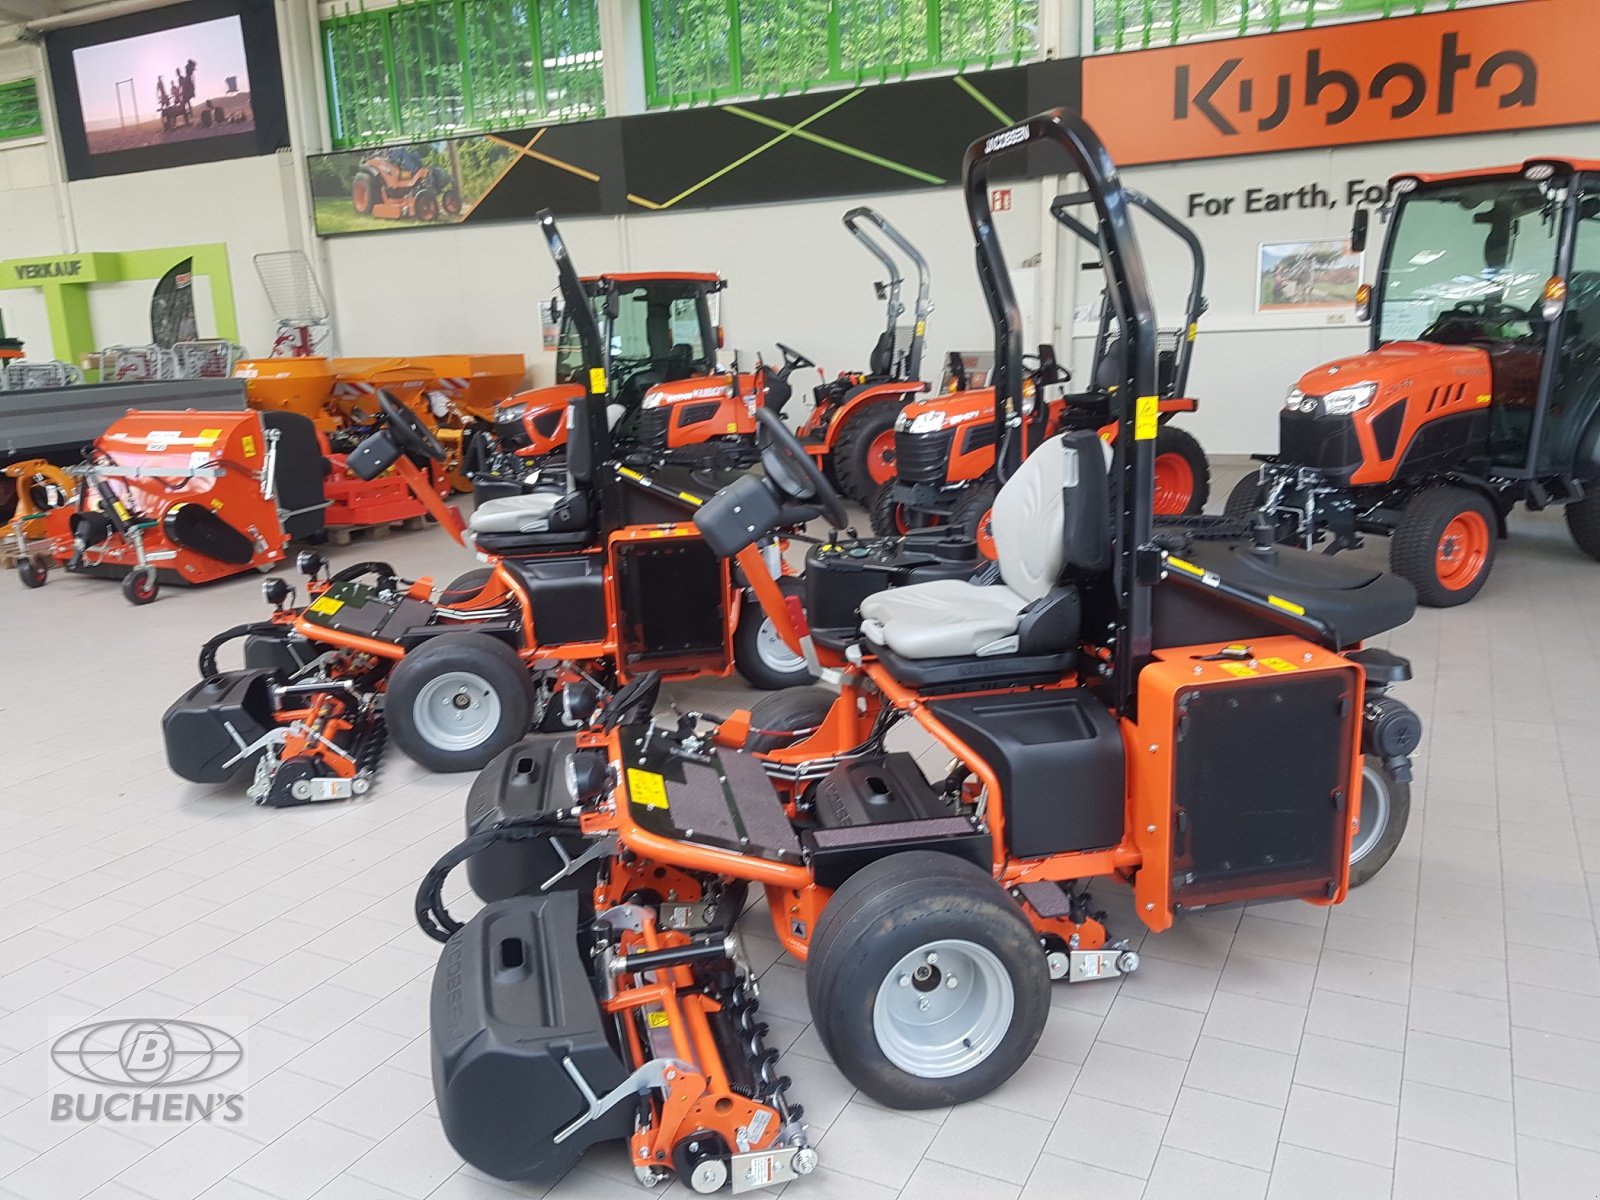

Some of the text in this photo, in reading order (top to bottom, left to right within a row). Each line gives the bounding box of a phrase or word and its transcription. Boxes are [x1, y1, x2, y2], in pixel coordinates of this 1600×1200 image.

[1174, 31, 1538, 136] Kubota
[984, 124, 1030, 154] JACOBSEN
[1188, 192, 1234, 217] For
[1245, 182, 1338, 214] Earth,
[14, 260, 82, 279] VERKAUF
